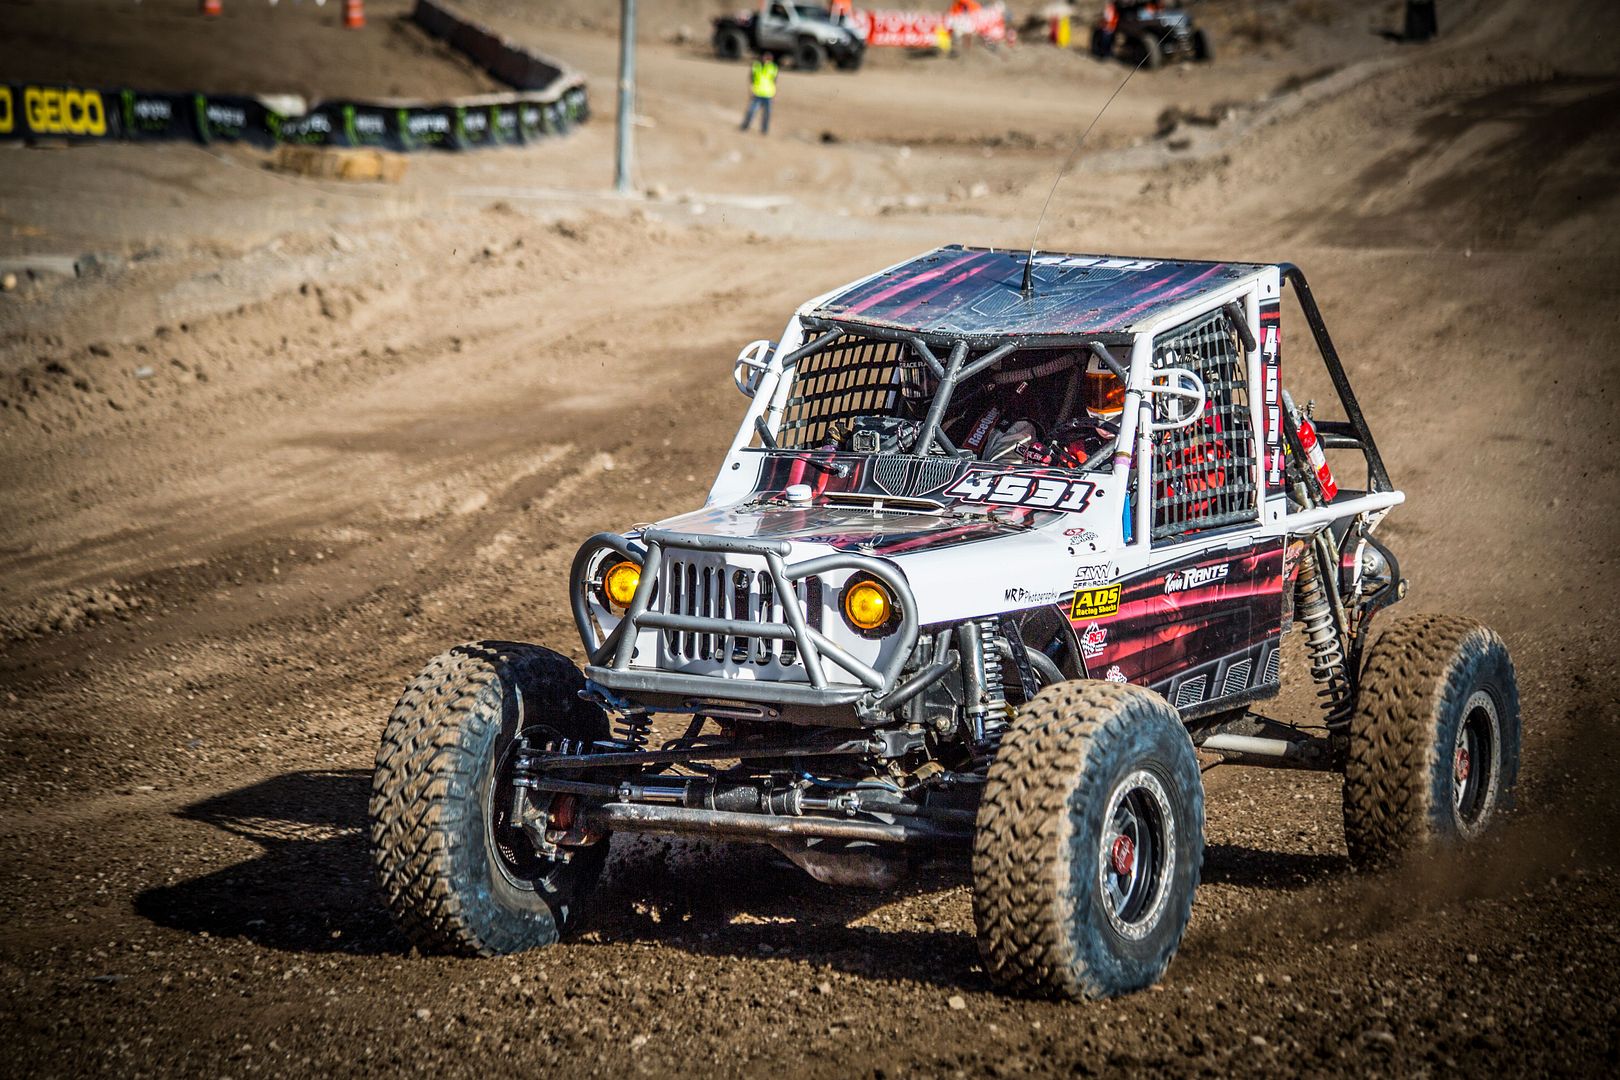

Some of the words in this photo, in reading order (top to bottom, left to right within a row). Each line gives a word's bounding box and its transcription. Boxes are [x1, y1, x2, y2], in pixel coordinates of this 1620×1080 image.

[24, 86, 107, 136] GEICO
[1263, 325, 1281, 486] 4531
[949, 473, 1092, 511] 4531
[1181, 563, 1229, 590] RANTS
[1075, 587, 1119, 609] ADS
[1076, 606, 1098, 617] Racing
[1098, 603, 1117, 613] Shocks
[1088, 629, 1107, 645] RCV
